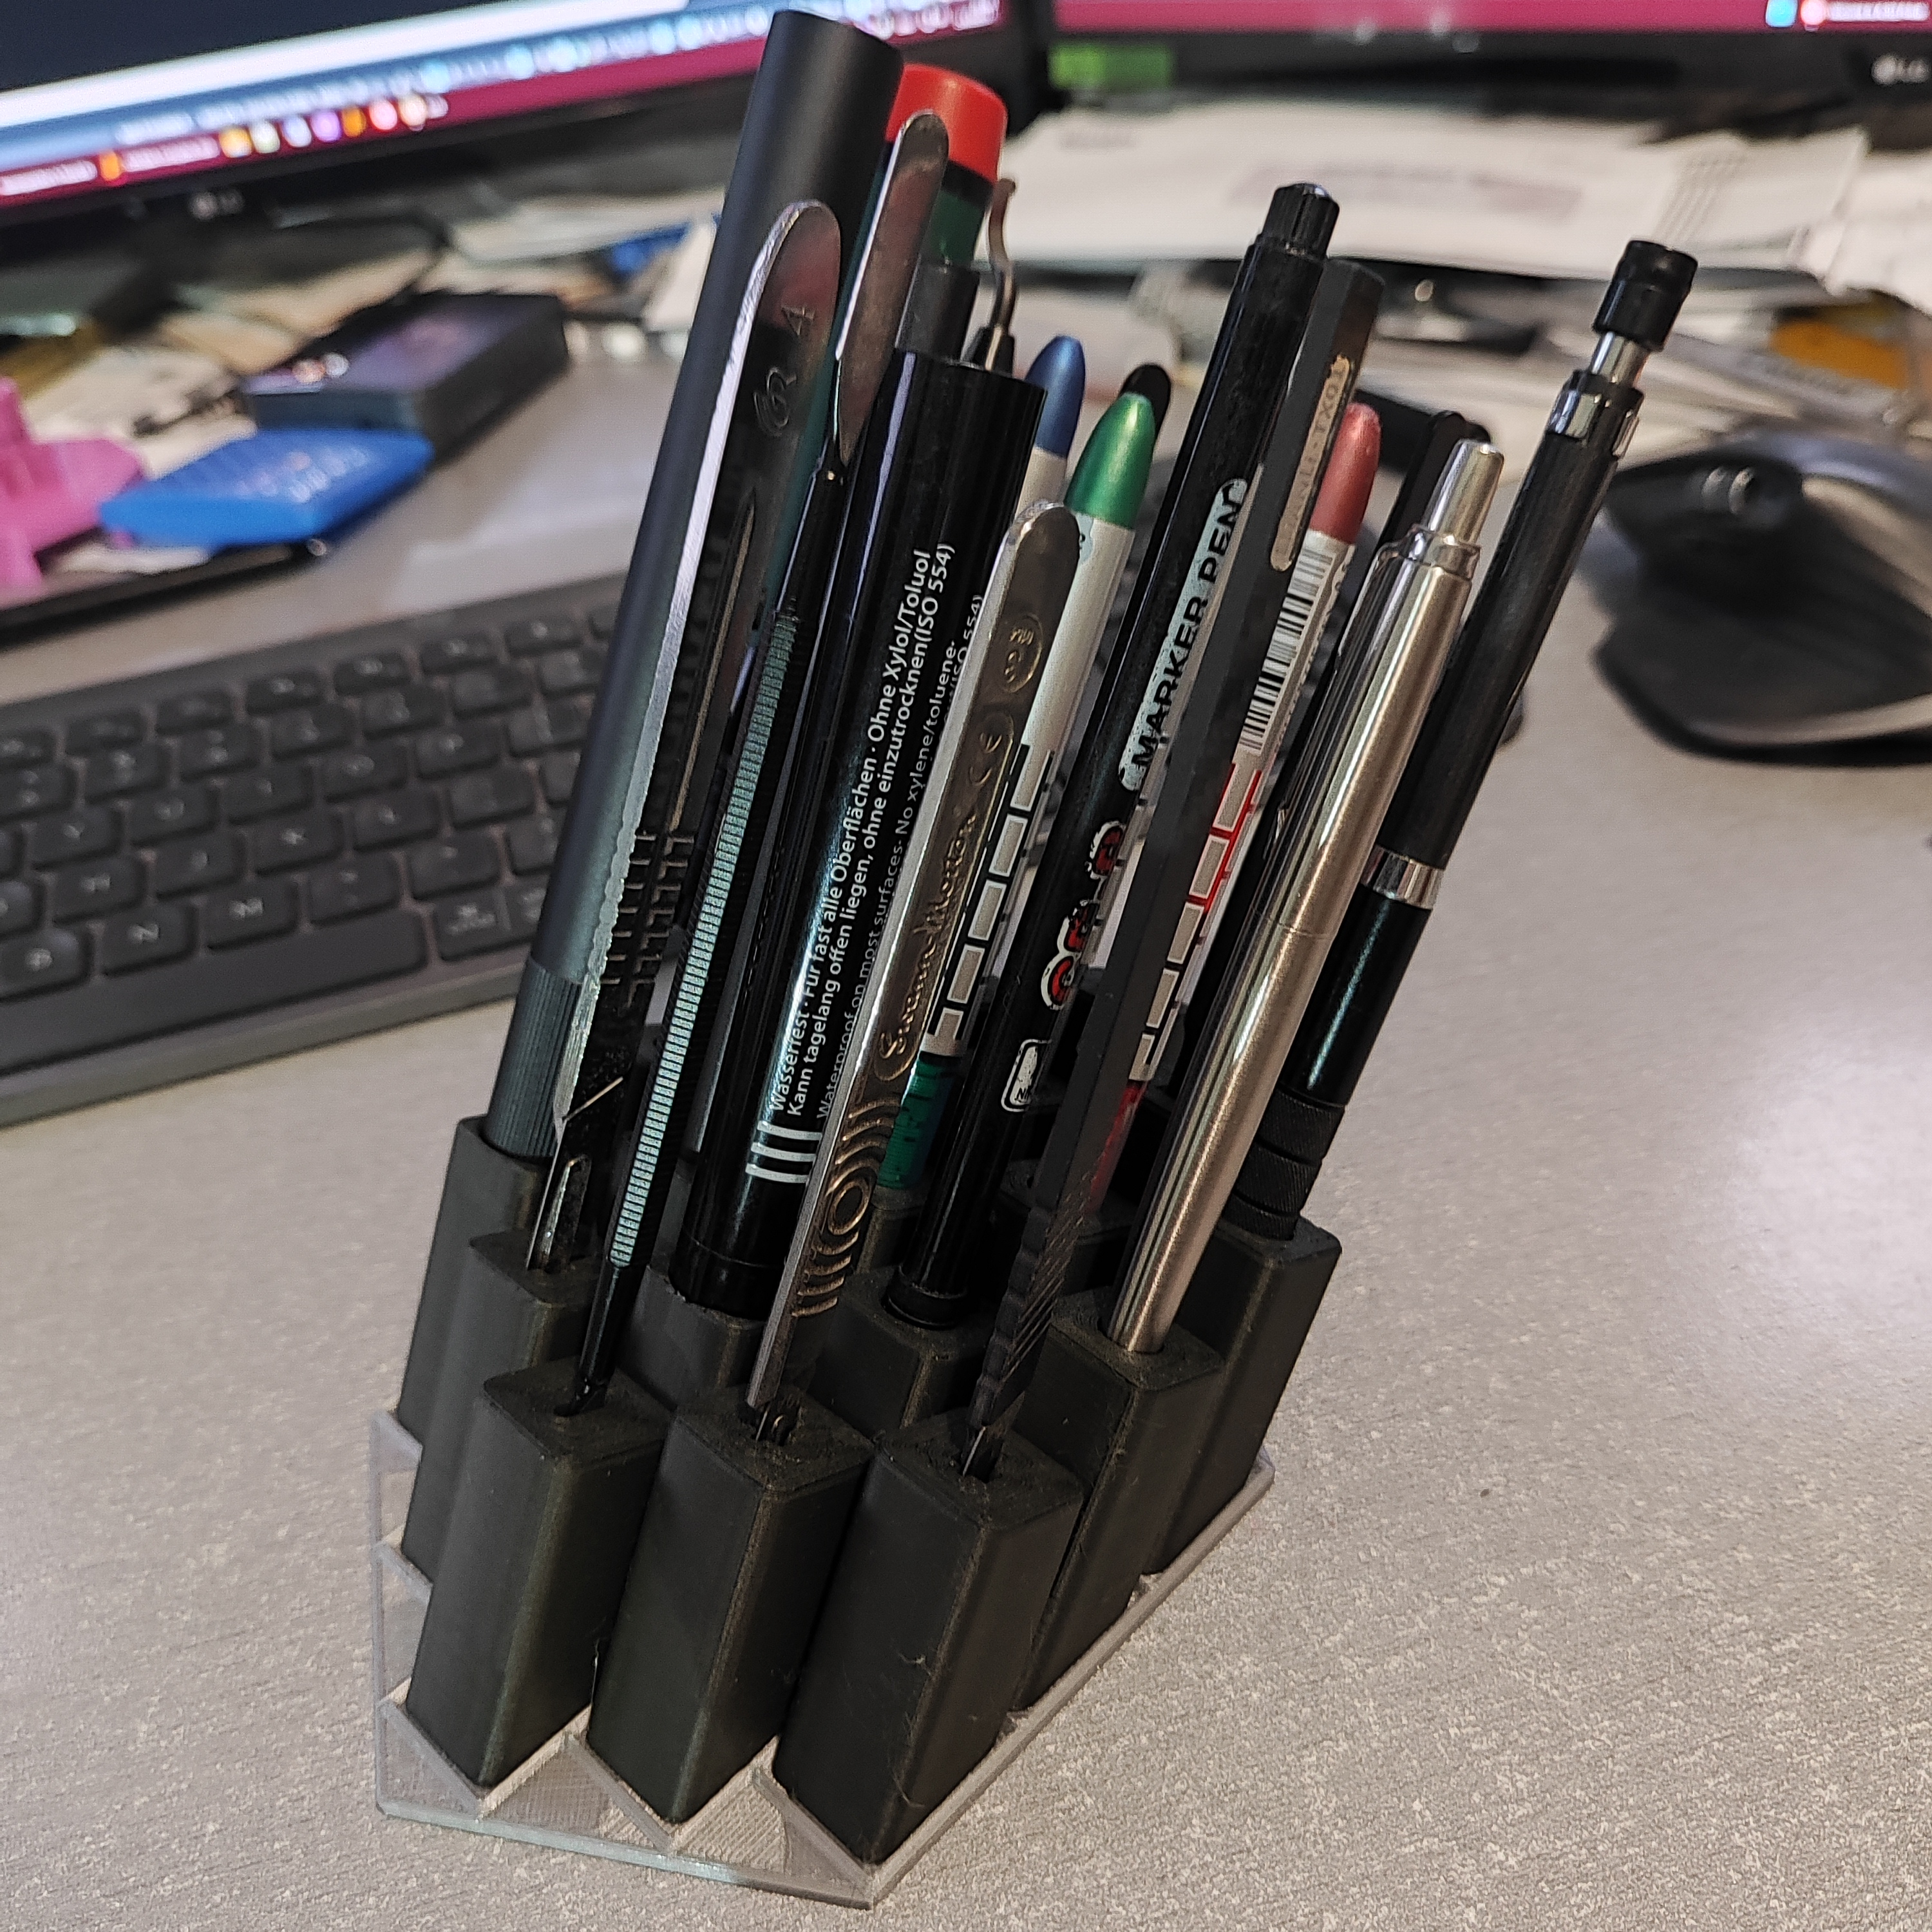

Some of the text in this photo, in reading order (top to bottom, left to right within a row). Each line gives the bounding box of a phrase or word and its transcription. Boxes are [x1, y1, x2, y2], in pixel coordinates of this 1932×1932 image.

[882, 549, 931, 681] Xylol/Toluol
[1130, 498, 1244, 770] MARKER PEN
[867, 684, 896, 741] Ohne
[786, 544, 955, 1115] Kann tagelang offen liegen, ohne einzutrocknen(ISO 554)
[837, 757, 876, 882] Oberflächen
[810, 923, 832, 961] fast
[818, 884, 842, 922] alle
[859, 931, 880, 978] most
[895, 806, 913, 834] No
[769, 1009, 810, 1110] Wasserfest
